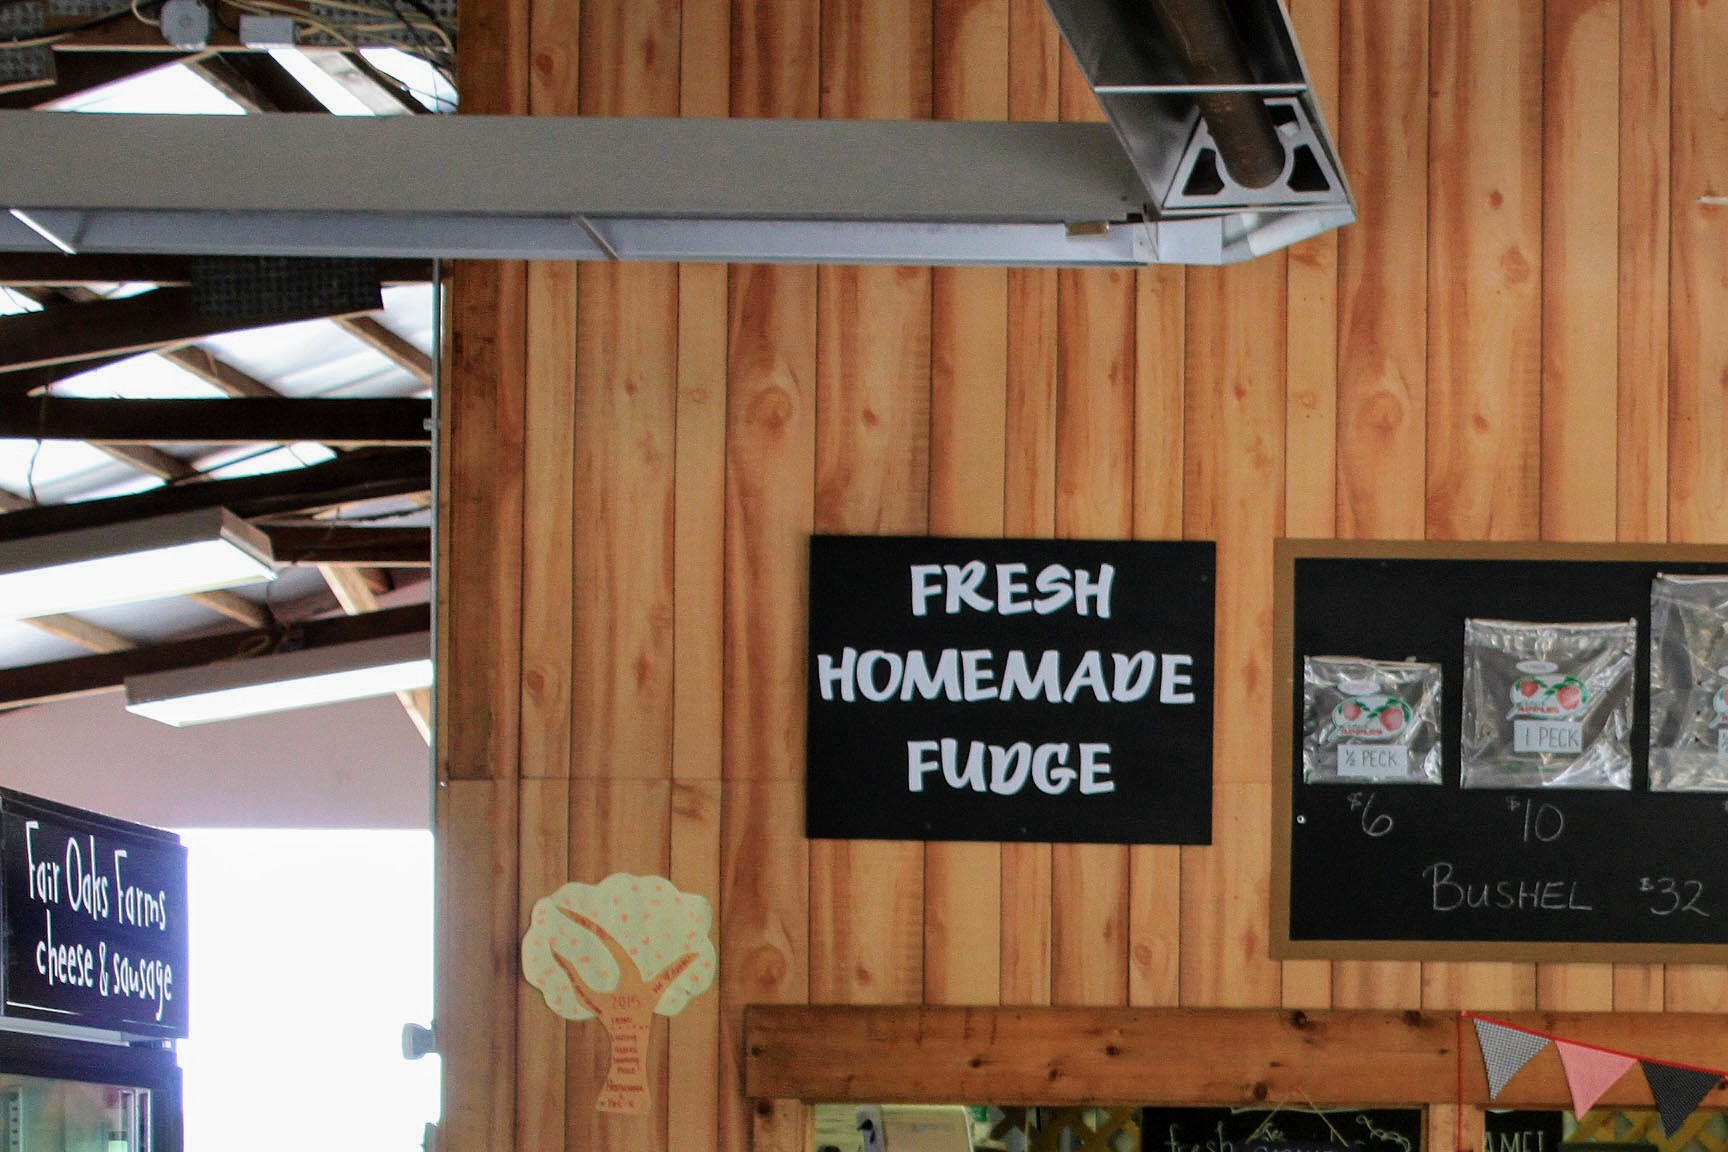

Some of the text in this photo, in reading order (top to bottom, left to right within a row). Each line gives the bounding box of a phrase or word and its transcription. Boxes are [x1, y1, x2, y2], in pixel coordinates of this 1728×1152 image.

[910, 560, 1115, 619] FRESH
[817, 647, 1195, 704] HOMEMADE
[1362, 749, 1398, 768] PECK
[1538, 726, 1579, 748] PECK
[907, 738, 1116, 795] FUDGE
[1347, 792, 1393, 836] $6
[1506, 798, 1564, 842] $10
[25, 820, 166, 931] Fair Oaks Farms
[1639, 876, 1710, 917] $32
[36, 908, 172, 1022] cheese & sausage
